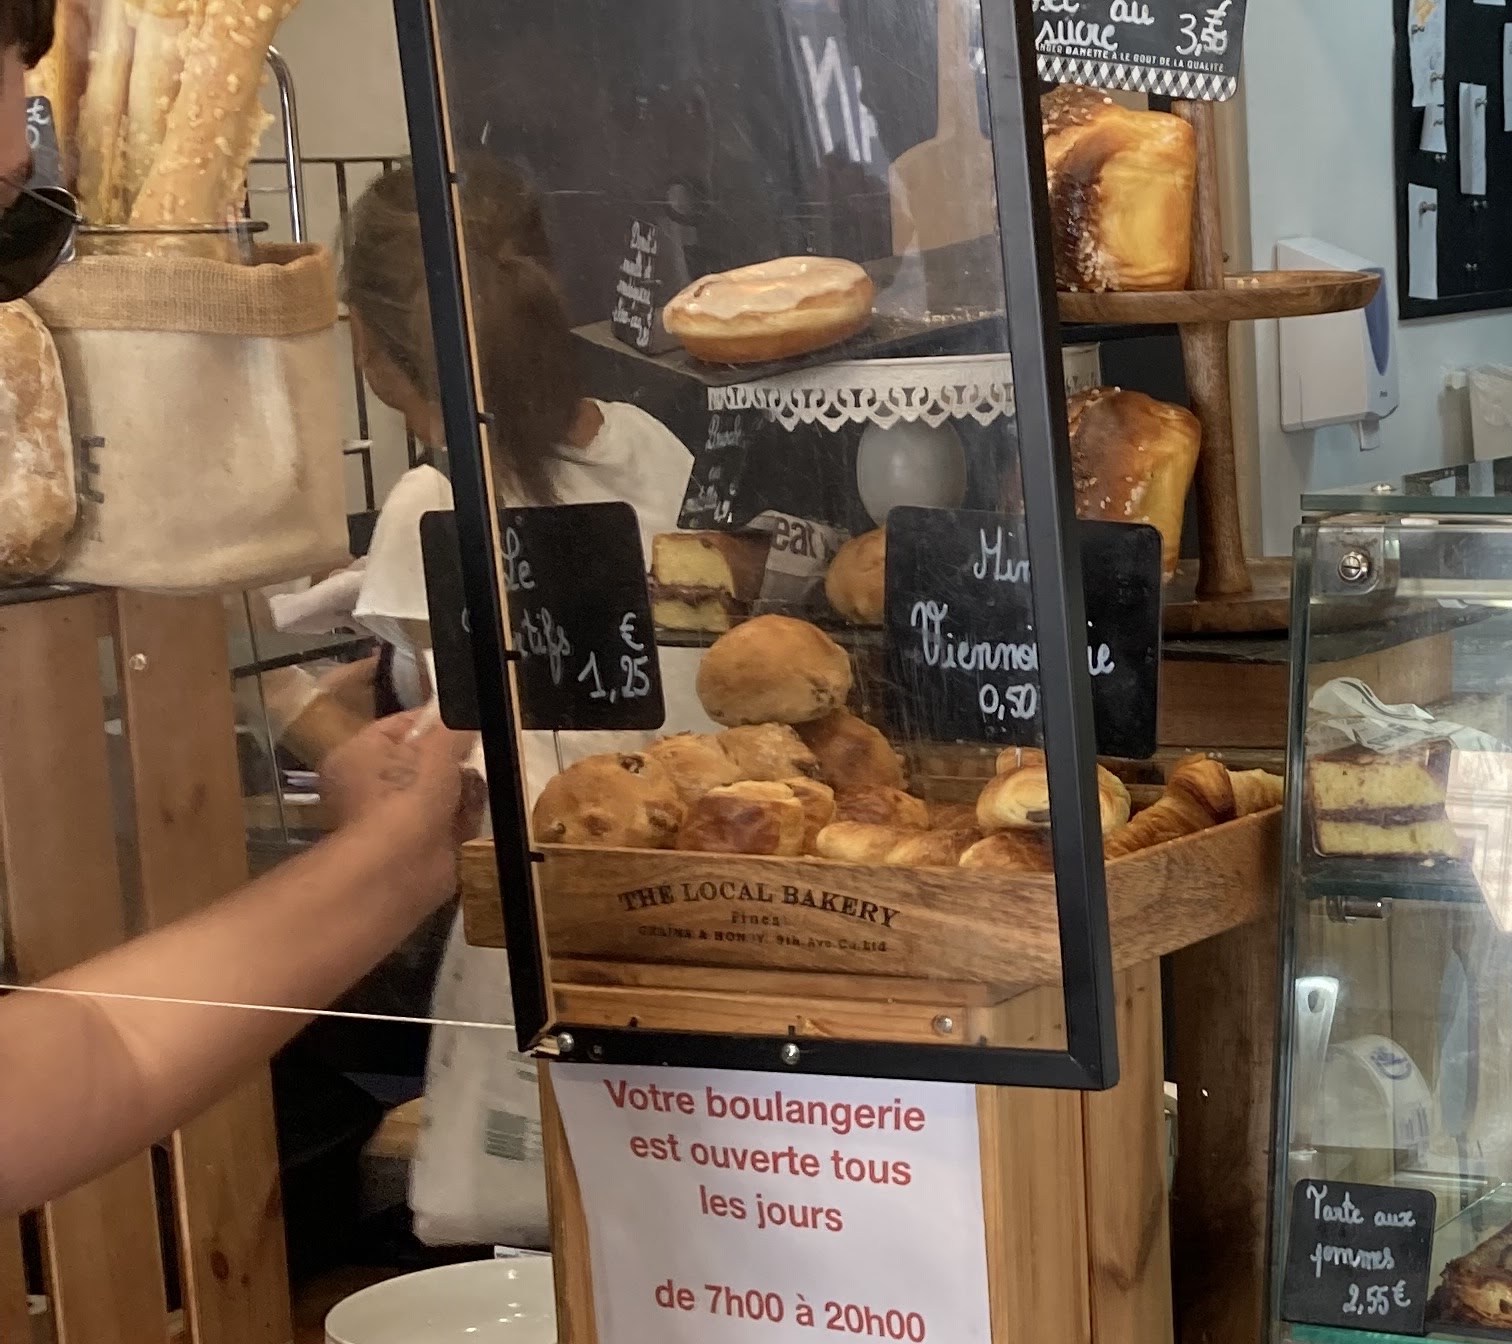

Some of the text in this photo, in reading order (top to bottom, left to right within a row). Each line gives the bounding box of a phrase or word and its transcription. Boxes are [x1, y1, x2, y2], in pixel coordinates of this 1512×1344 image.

[1035, 20, 1118, 51] sucre
[973, 526, 1031, 583] Min
[617, 881, 901, 928] THE LOCAL BAKERY
[603, 1079, 926, 1135] Votre boulangerie
[629, 1134, 912, 1186] est ouverte tous
[700, 1185, 844, 1232] les jours
[1306, 1184, 1416, 1227] Tarte aux
[1309, 1242, 1395, 1278] pommes
[655, 1279, 926, 1343] de 7h00 à 20h00
[1342, 1279, 1411, 1315] 2,55€
